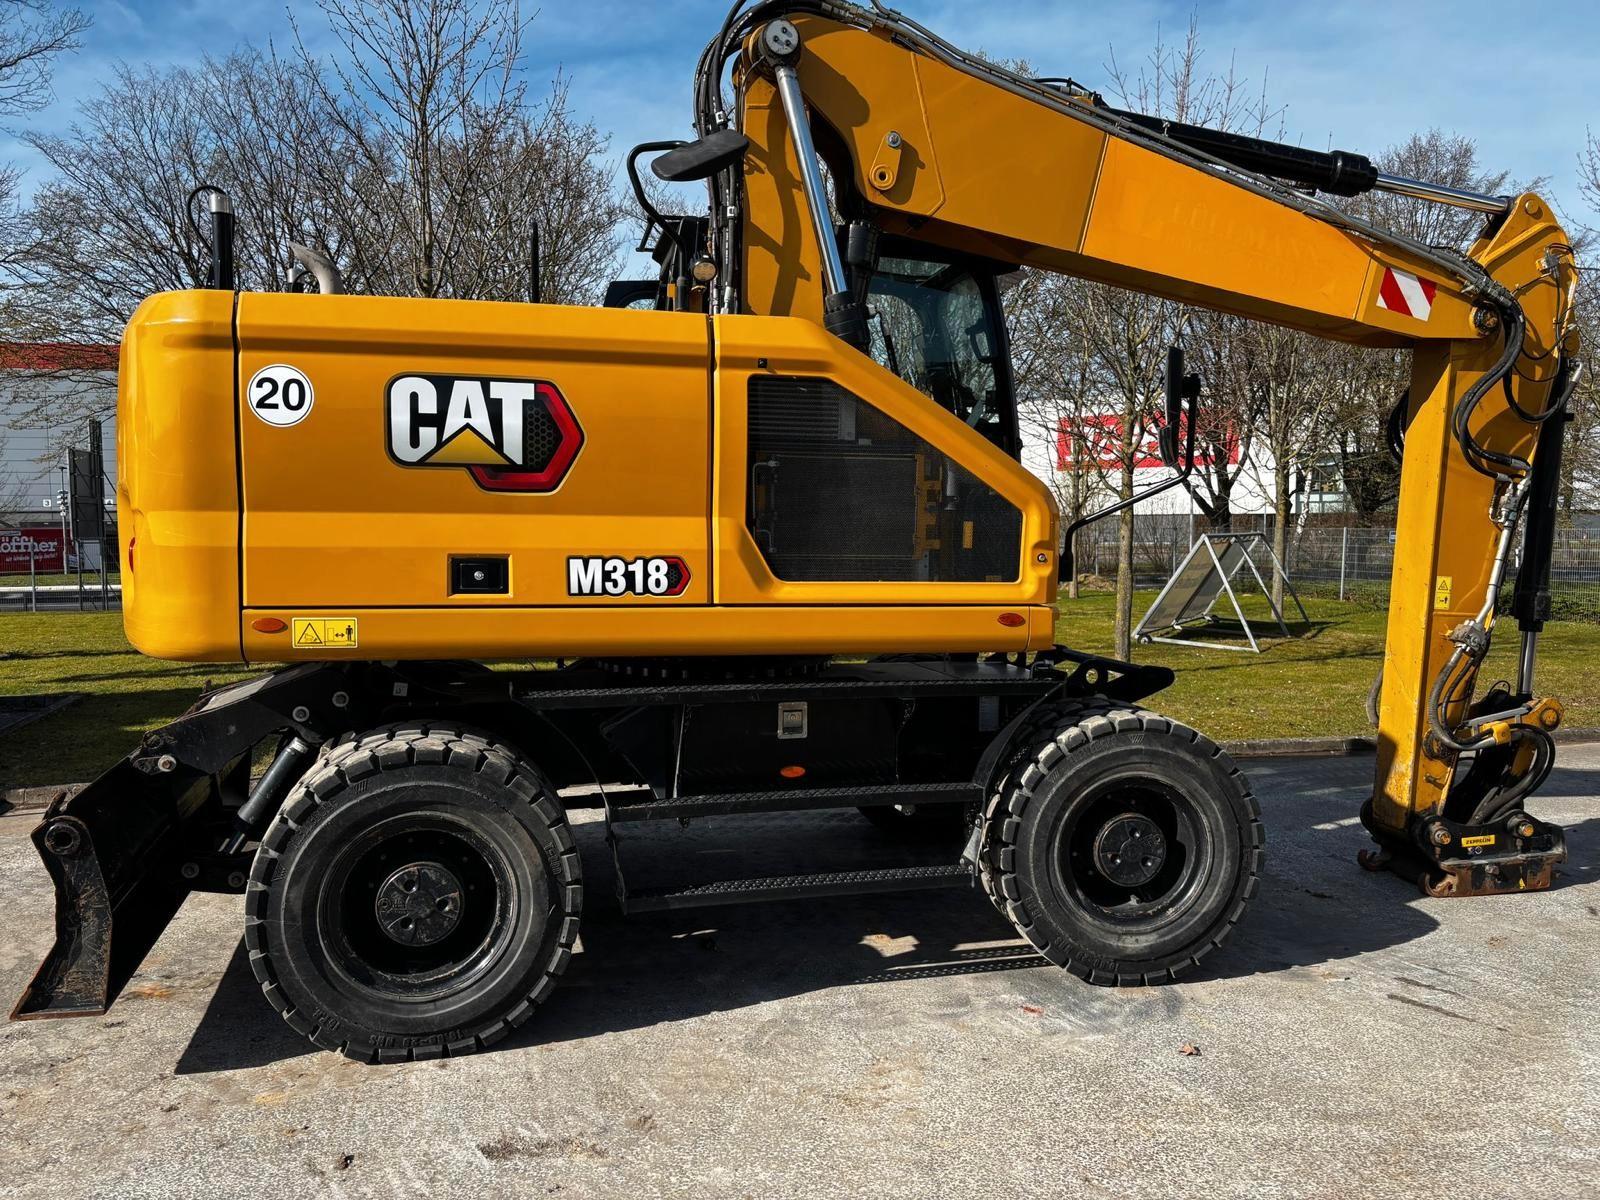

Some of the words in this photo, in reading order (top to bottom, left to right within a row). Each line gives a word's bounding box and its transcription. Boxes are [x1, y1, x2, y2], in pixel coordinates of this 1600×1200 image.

[256, 377, 306, 412] 20
[390, 376, 535, 465] CAT
[569, 558, 669, 594] M318
